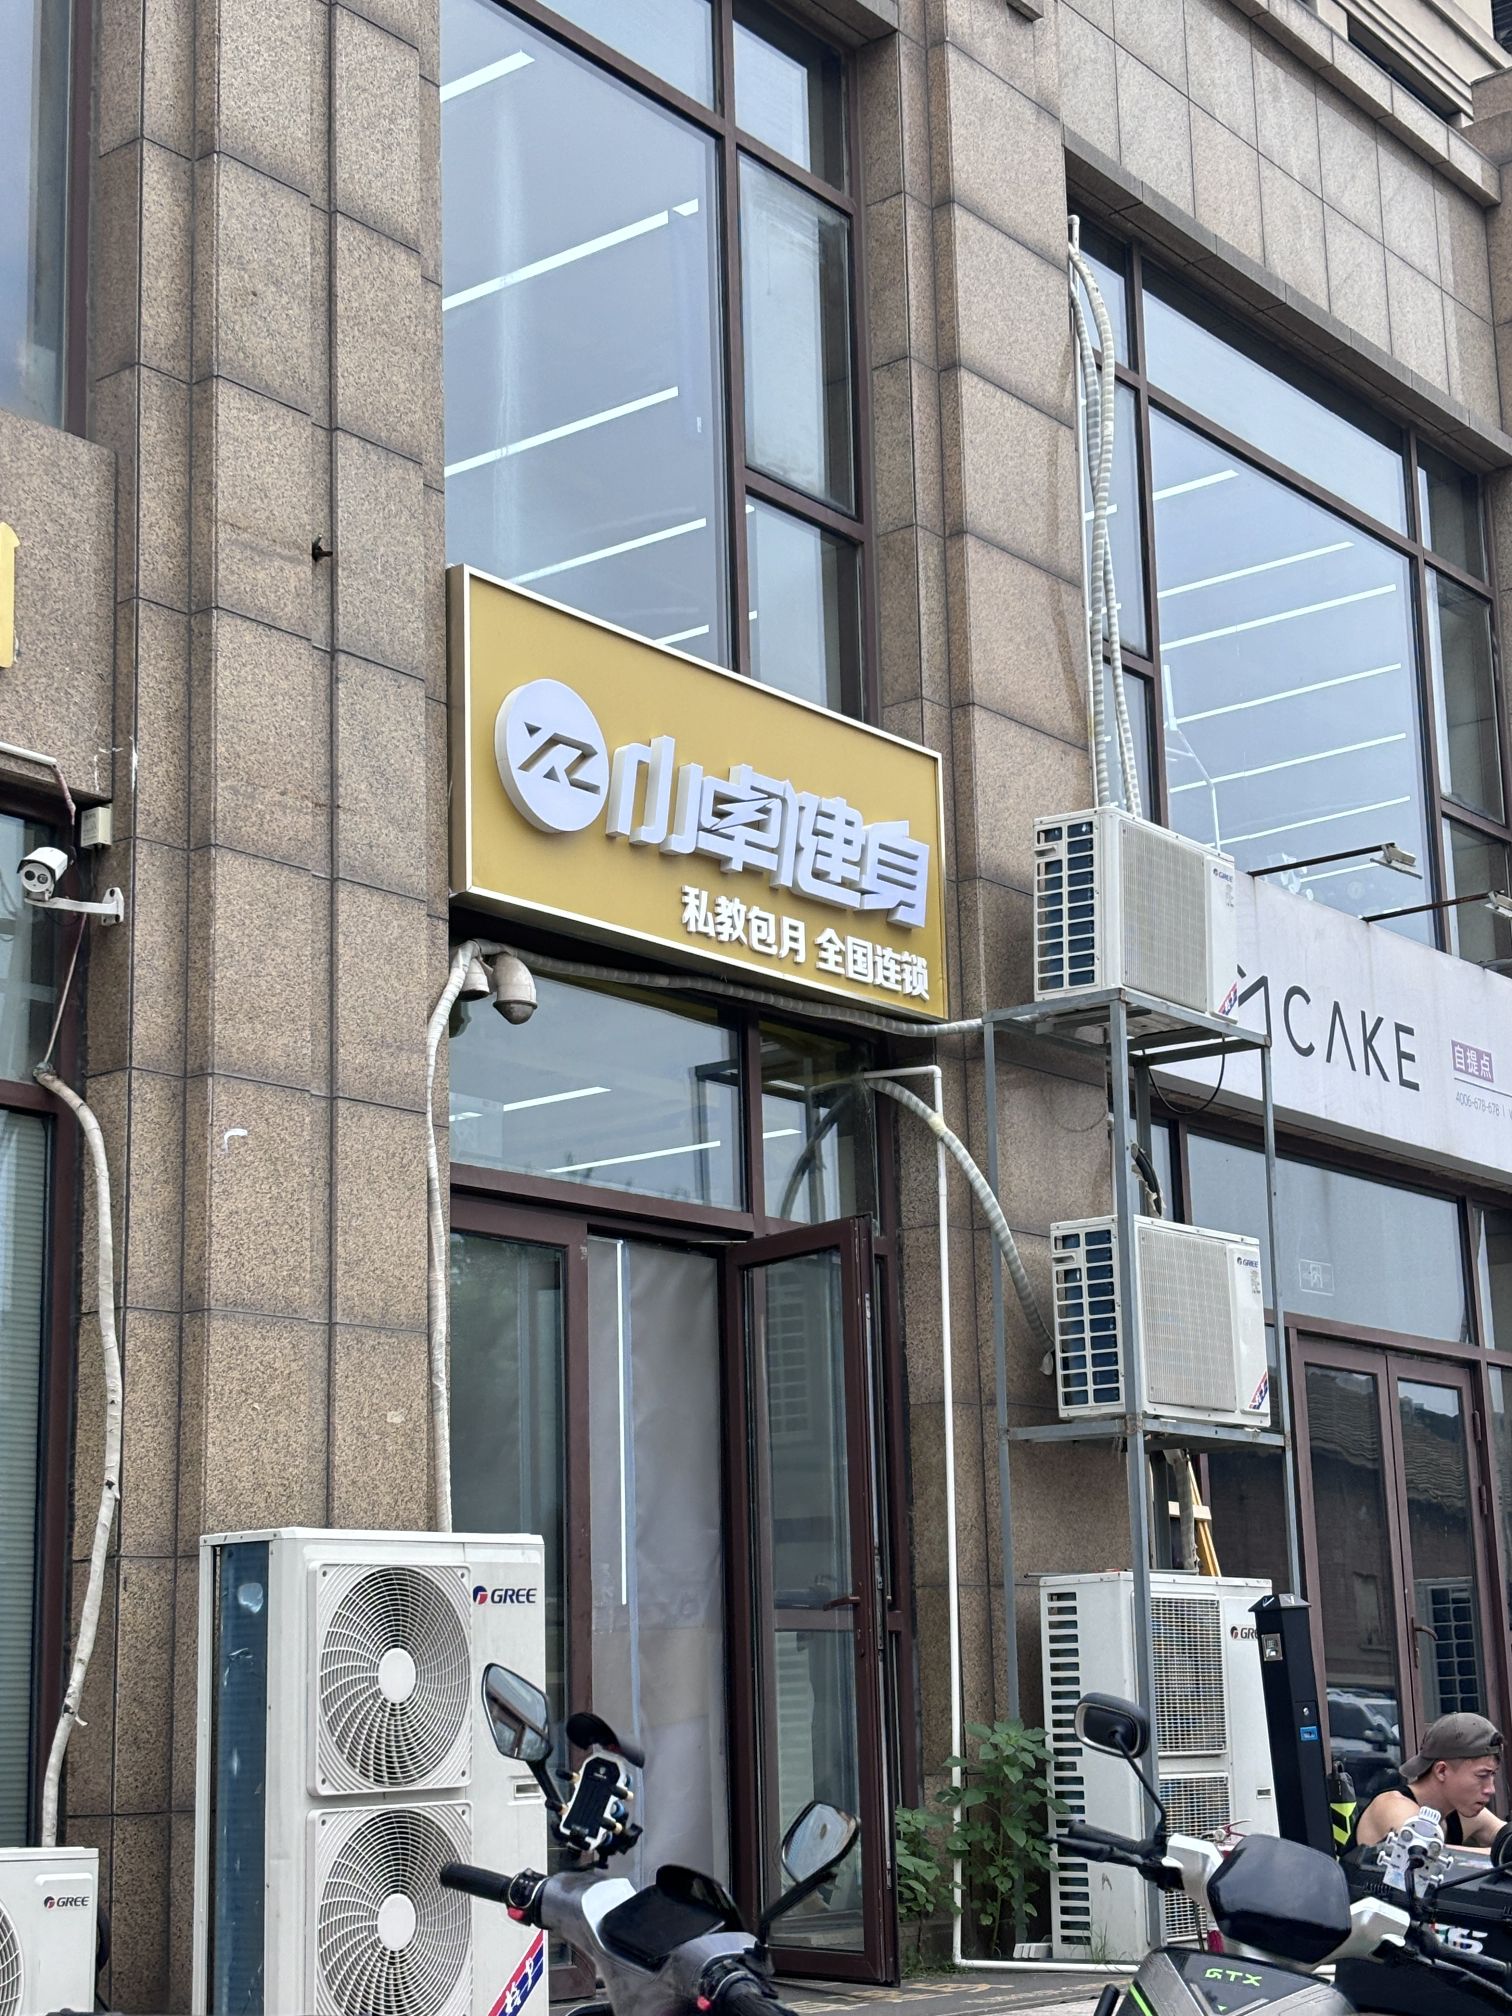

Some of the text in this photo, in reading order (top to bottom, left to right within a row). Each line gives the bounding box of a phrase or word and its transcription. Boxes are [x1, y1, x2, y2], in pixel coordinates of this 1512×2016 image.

[681, 884, 930, 1001] 私教包月 全国连锁
[1454, 1043, 1492, 1080] 自提点
[490, 1587, 538, 1605] GREE
[56, 1896, 90, 1908] GREE
[1204, 1967, 1262, 1987] GTX
